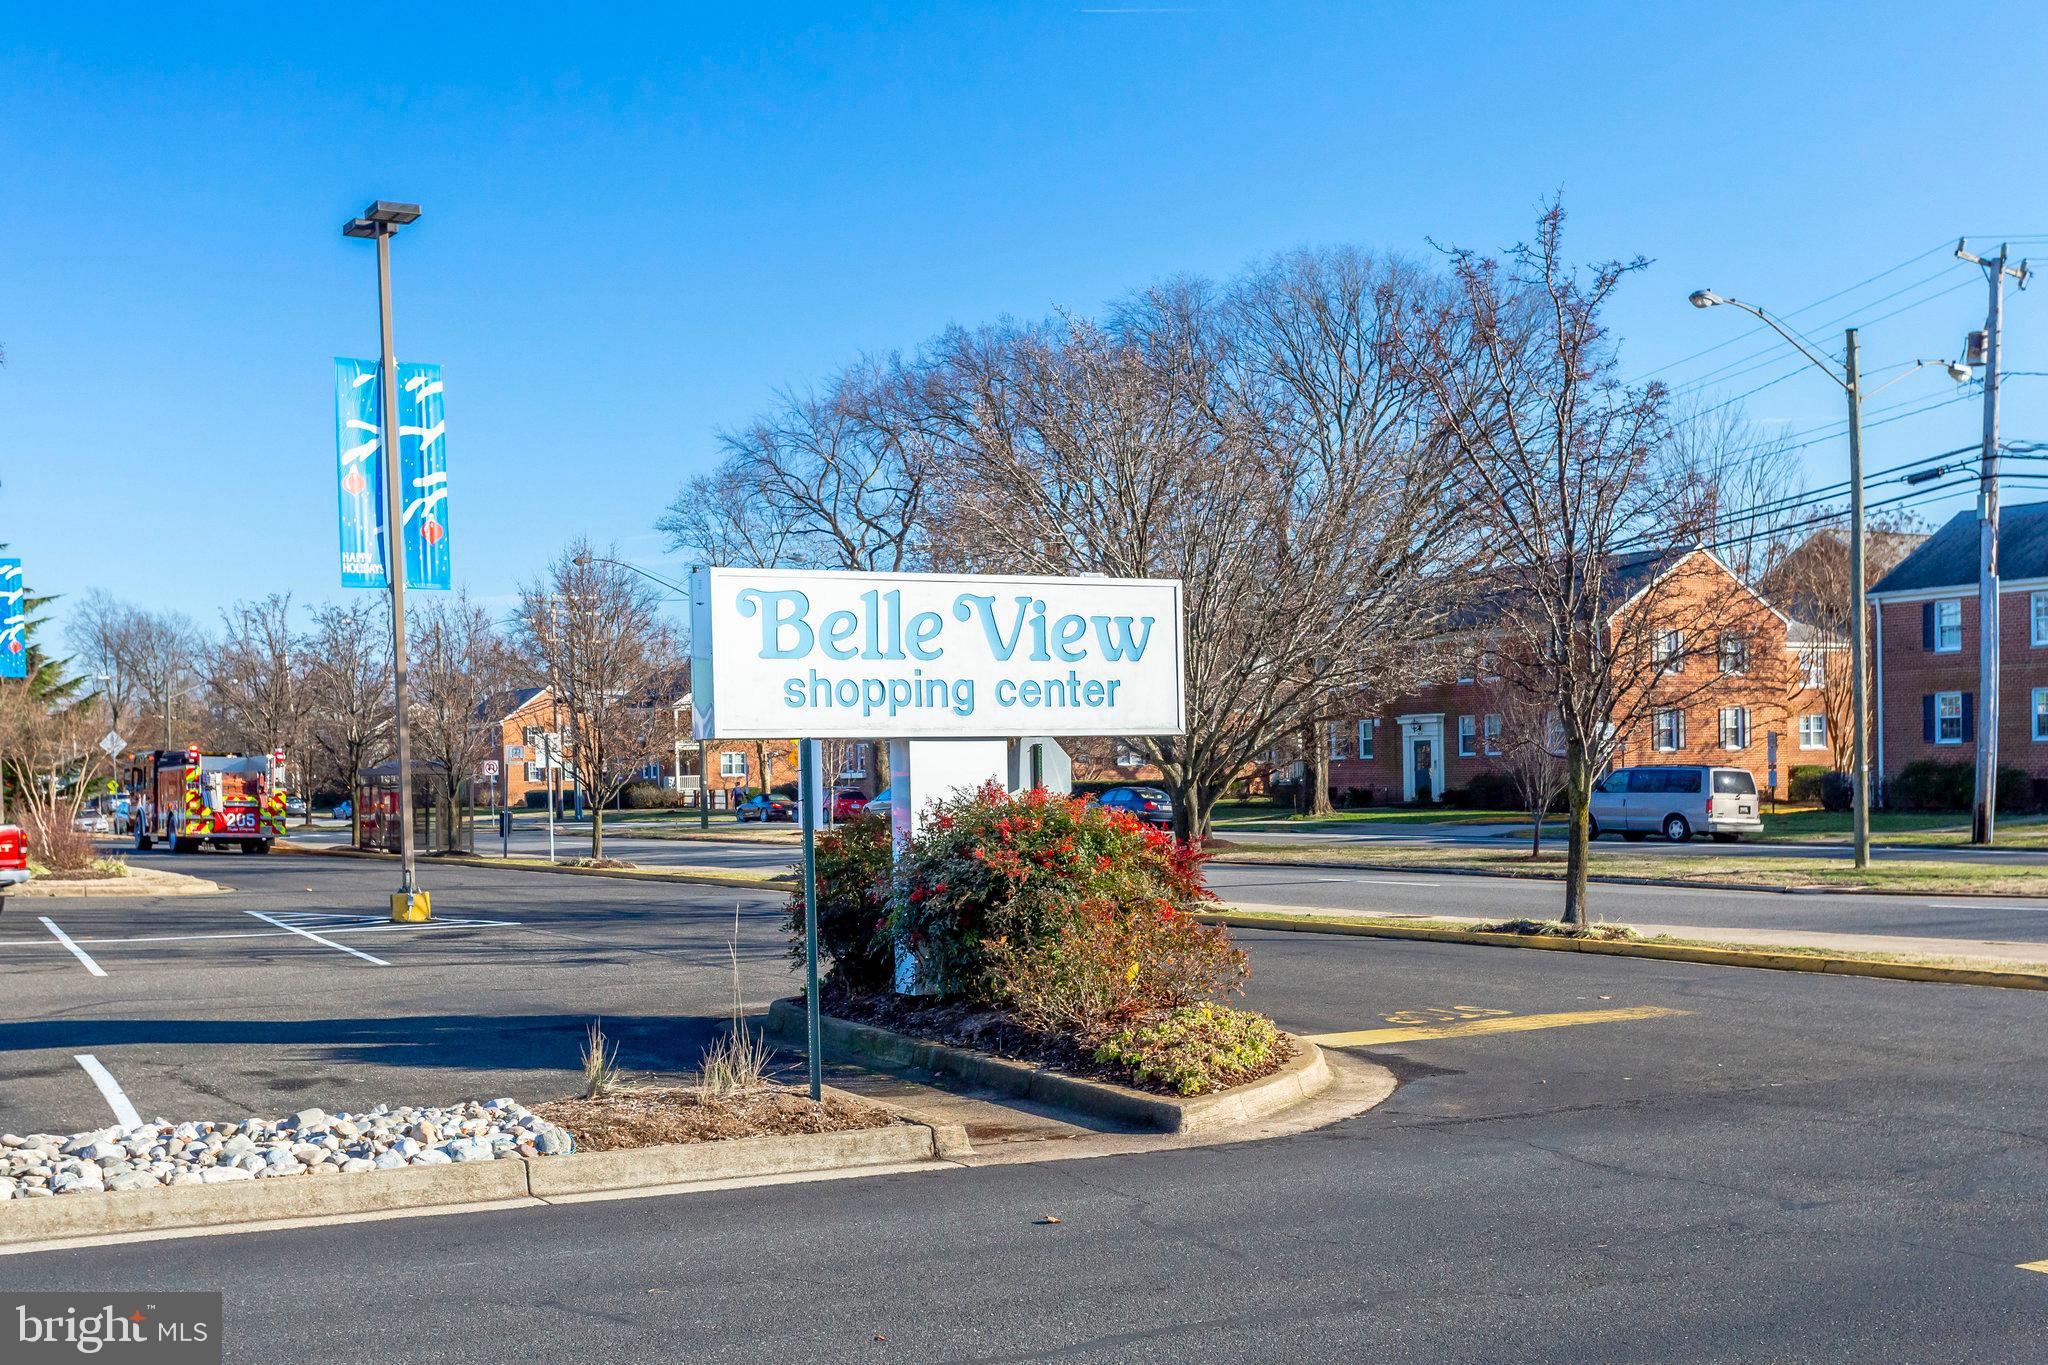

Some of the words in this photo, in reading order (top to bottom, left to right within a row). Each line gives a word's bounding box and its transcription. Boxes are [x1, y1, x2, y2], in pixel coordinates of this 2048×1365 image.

[341, 551, 373, 563] HAPPY
[342, 562, 384, 574] HOLIDAYS
[735, 587, 944, 662] Belle
[952, 593, 1156, 664] View
[783, 669, 975, 717] shopping
[994, 671, 1121, 709] center
[226, 813, 256, 827] 205
